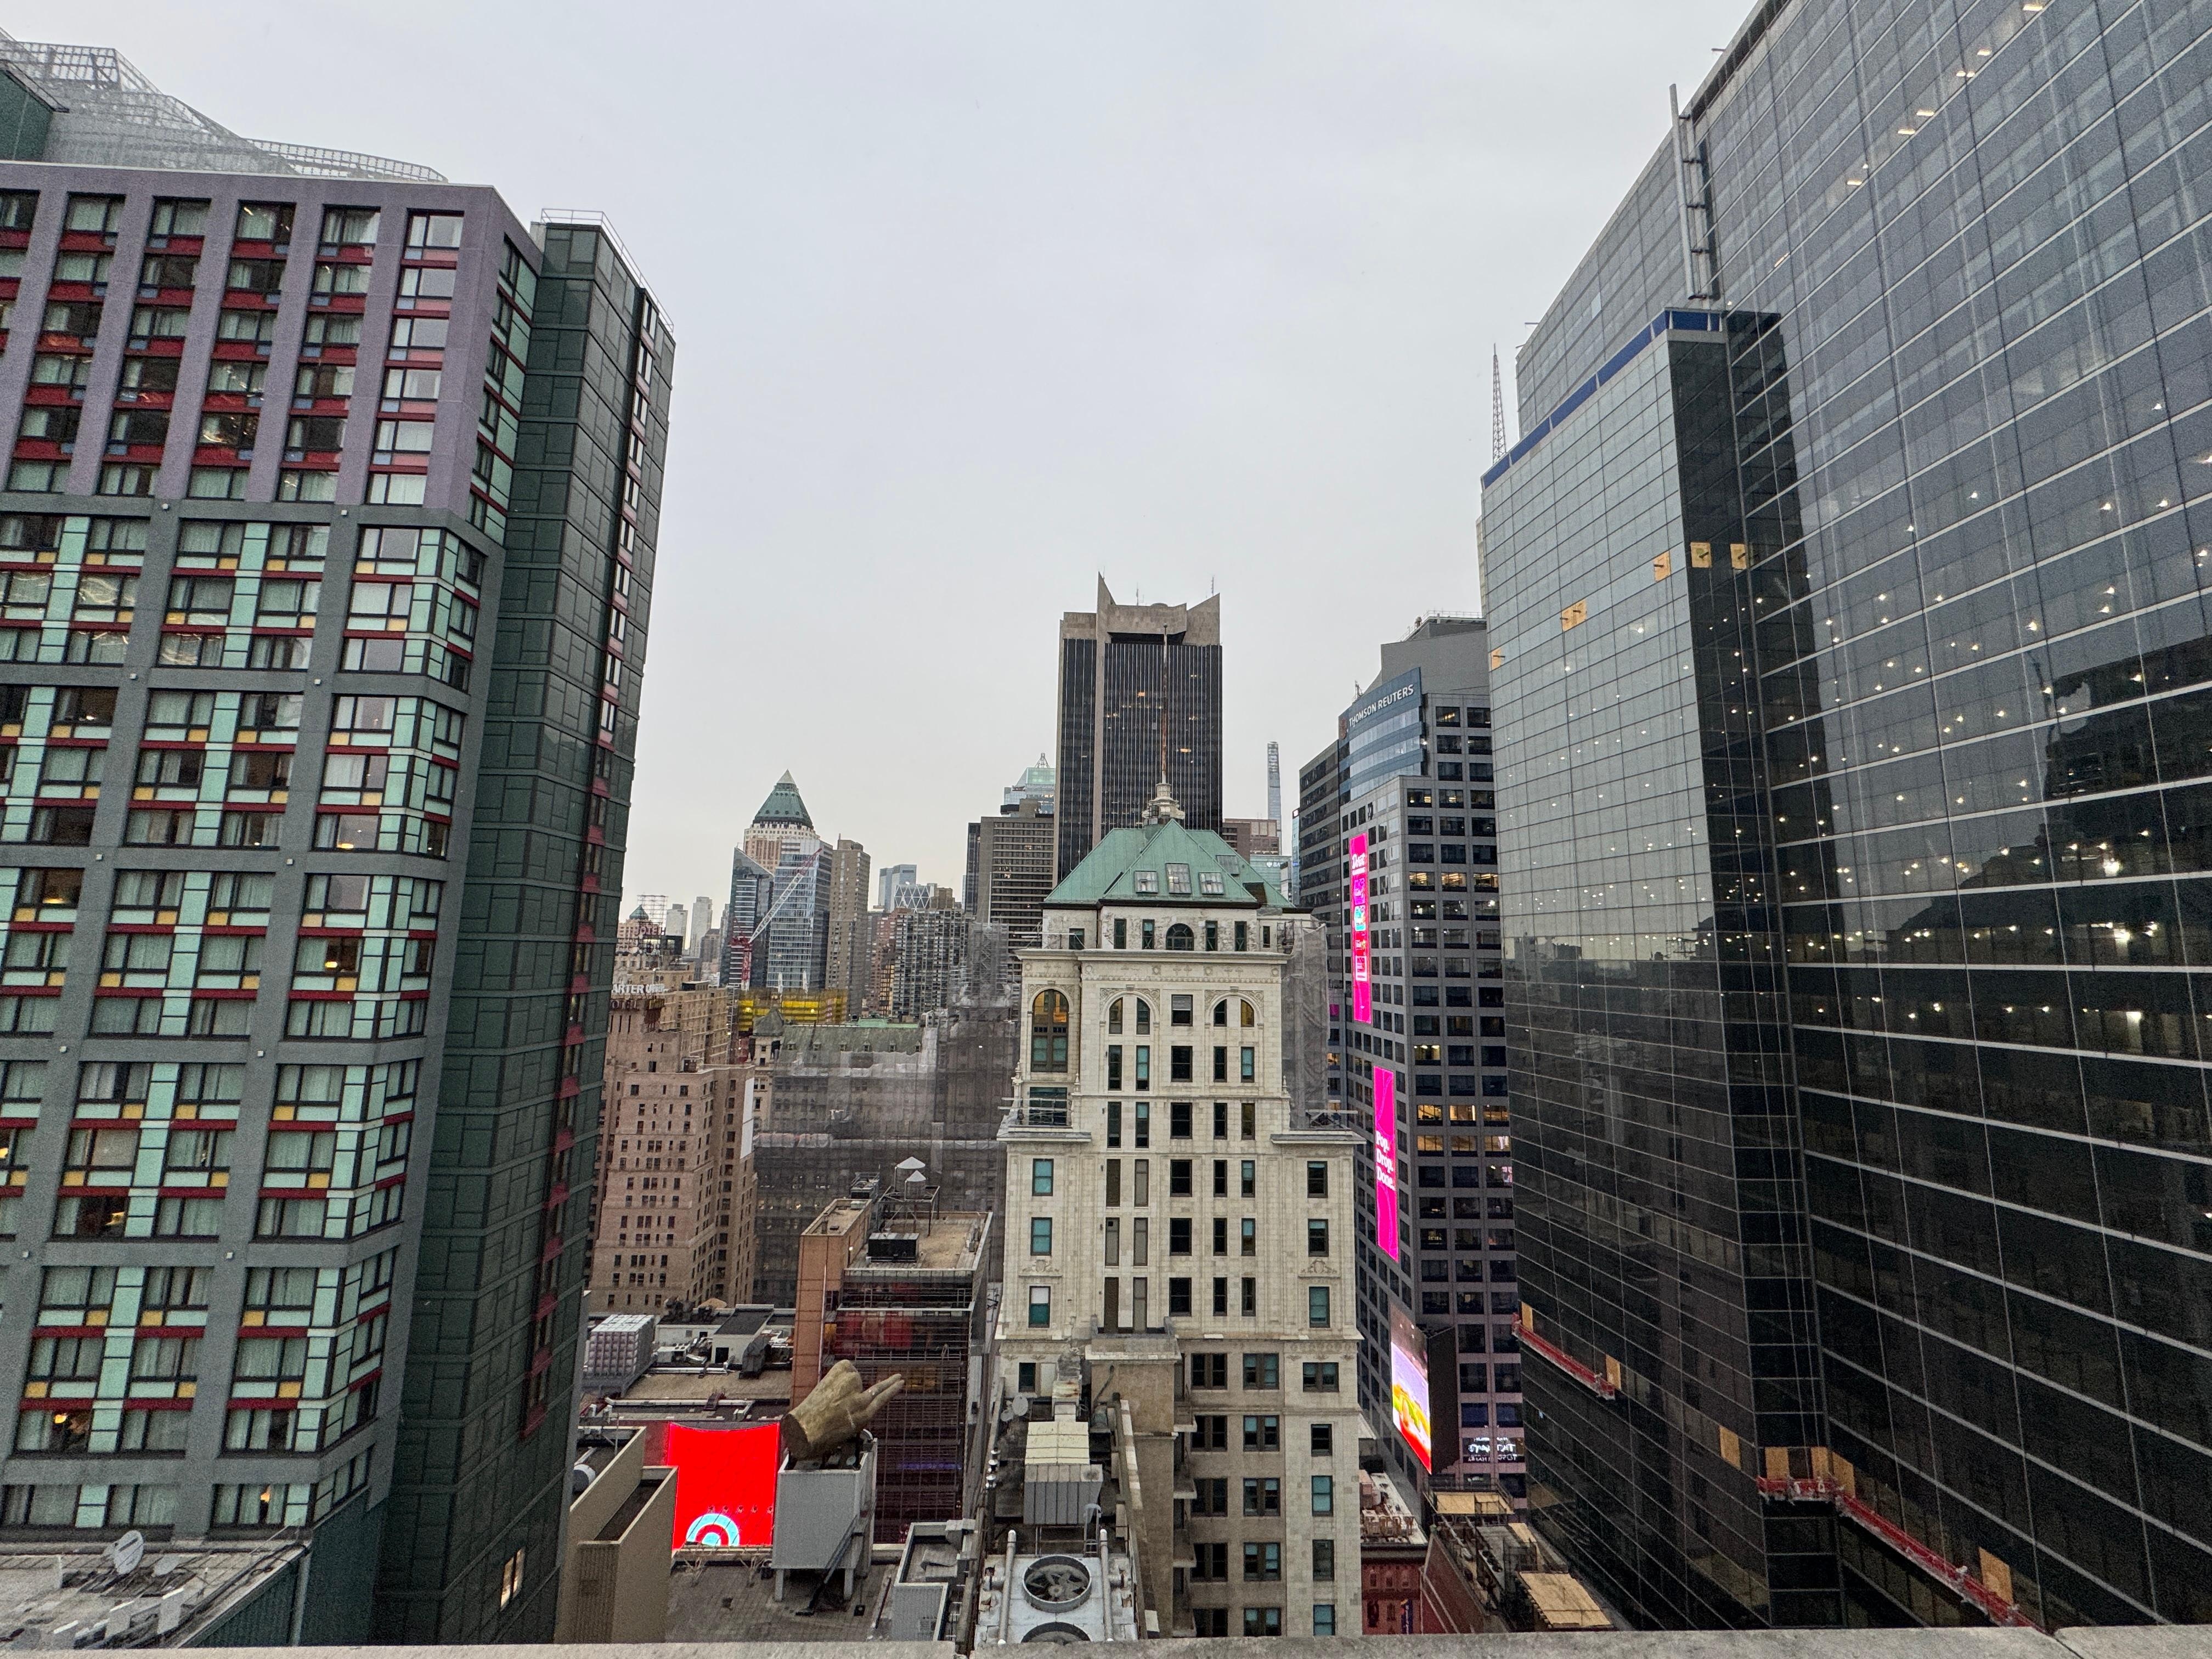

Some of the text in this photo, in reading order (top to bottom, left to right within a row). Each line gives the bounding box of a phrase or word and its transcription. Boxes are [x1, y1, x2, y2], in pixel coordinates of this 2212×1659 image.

[1349, 684, 1414, 727] THOMSON REUTERS
[611, 983, 645, 995] ARTER
[1376, 1148, 1394, 1174] Drop.
[1376, 1165, 1396, 1192] Done.
